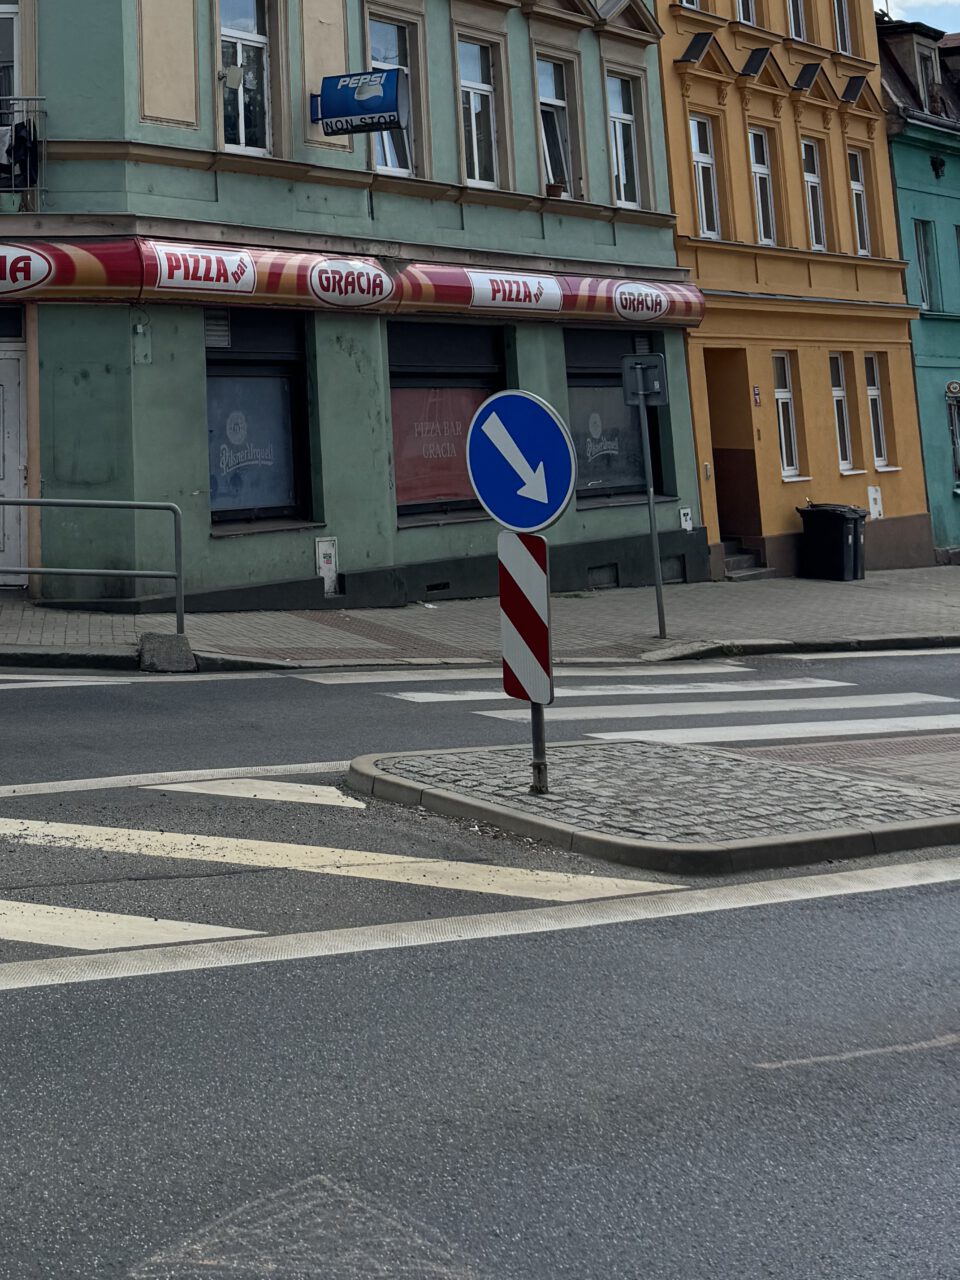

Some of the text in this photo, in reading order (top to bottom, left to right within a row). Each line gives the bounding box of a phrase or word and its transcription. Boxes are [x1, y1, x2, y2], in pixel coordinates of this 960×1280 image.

[336, 72, 388, 90] PEPSI
[325, 115, 396, 132] NON STOP
[164, 252, 248, 285] PIZZA bar
[317, 269, 384, 297] GRACIA
[489, 278, 544, 304] PIZZA bar
[619, 291, 662, 313] GRACIA
[413, 420, 462, 437] PIZZA BAR
[422, 442, 457, 459] GRACIA
